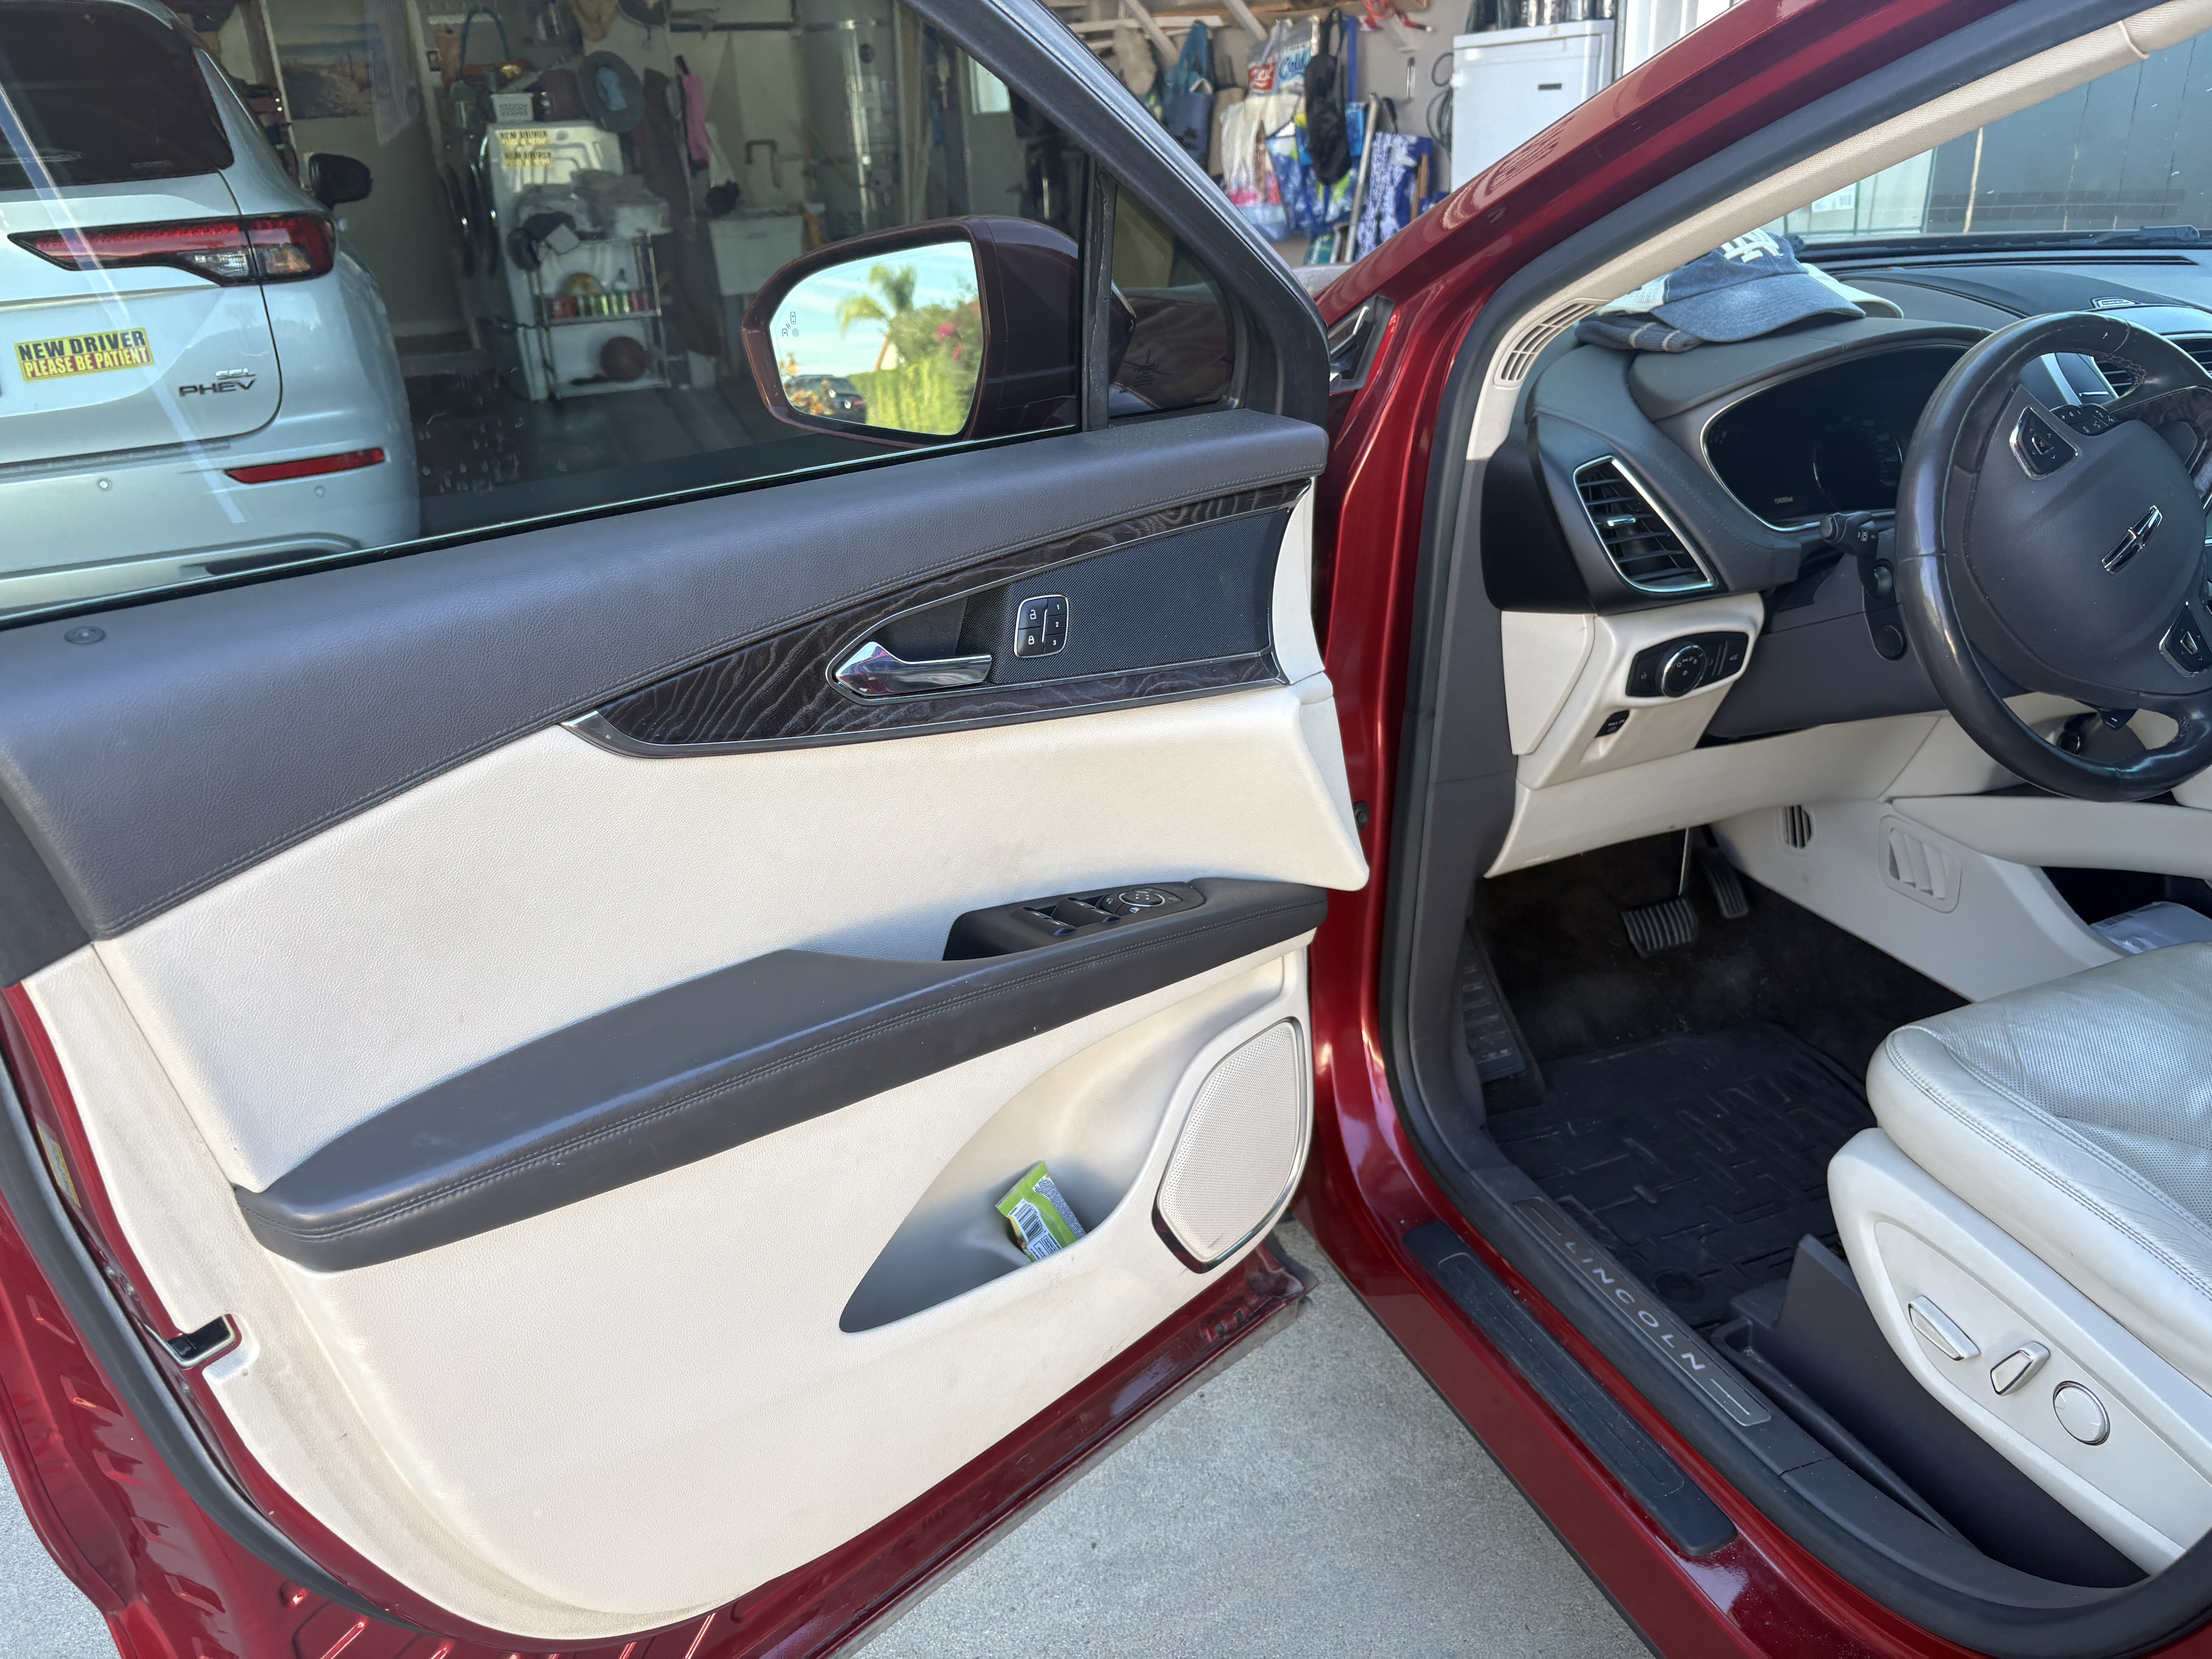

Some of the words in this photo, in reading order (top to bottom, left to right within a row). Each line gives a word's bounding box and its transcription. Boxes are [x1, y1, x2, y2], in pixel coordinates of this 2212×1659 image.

[18, 340, 65, 361] NEW
[69, 331, 146, 354] DRIVER
[24, 356, 74, 378] PLEASE
[74, 353, 94, 371] BE
[94, 347, 150, 369] PATIENT
[179, 378, 257, 397] PHEV
[1566, 1242, 1706, 1371] LINCOLN
